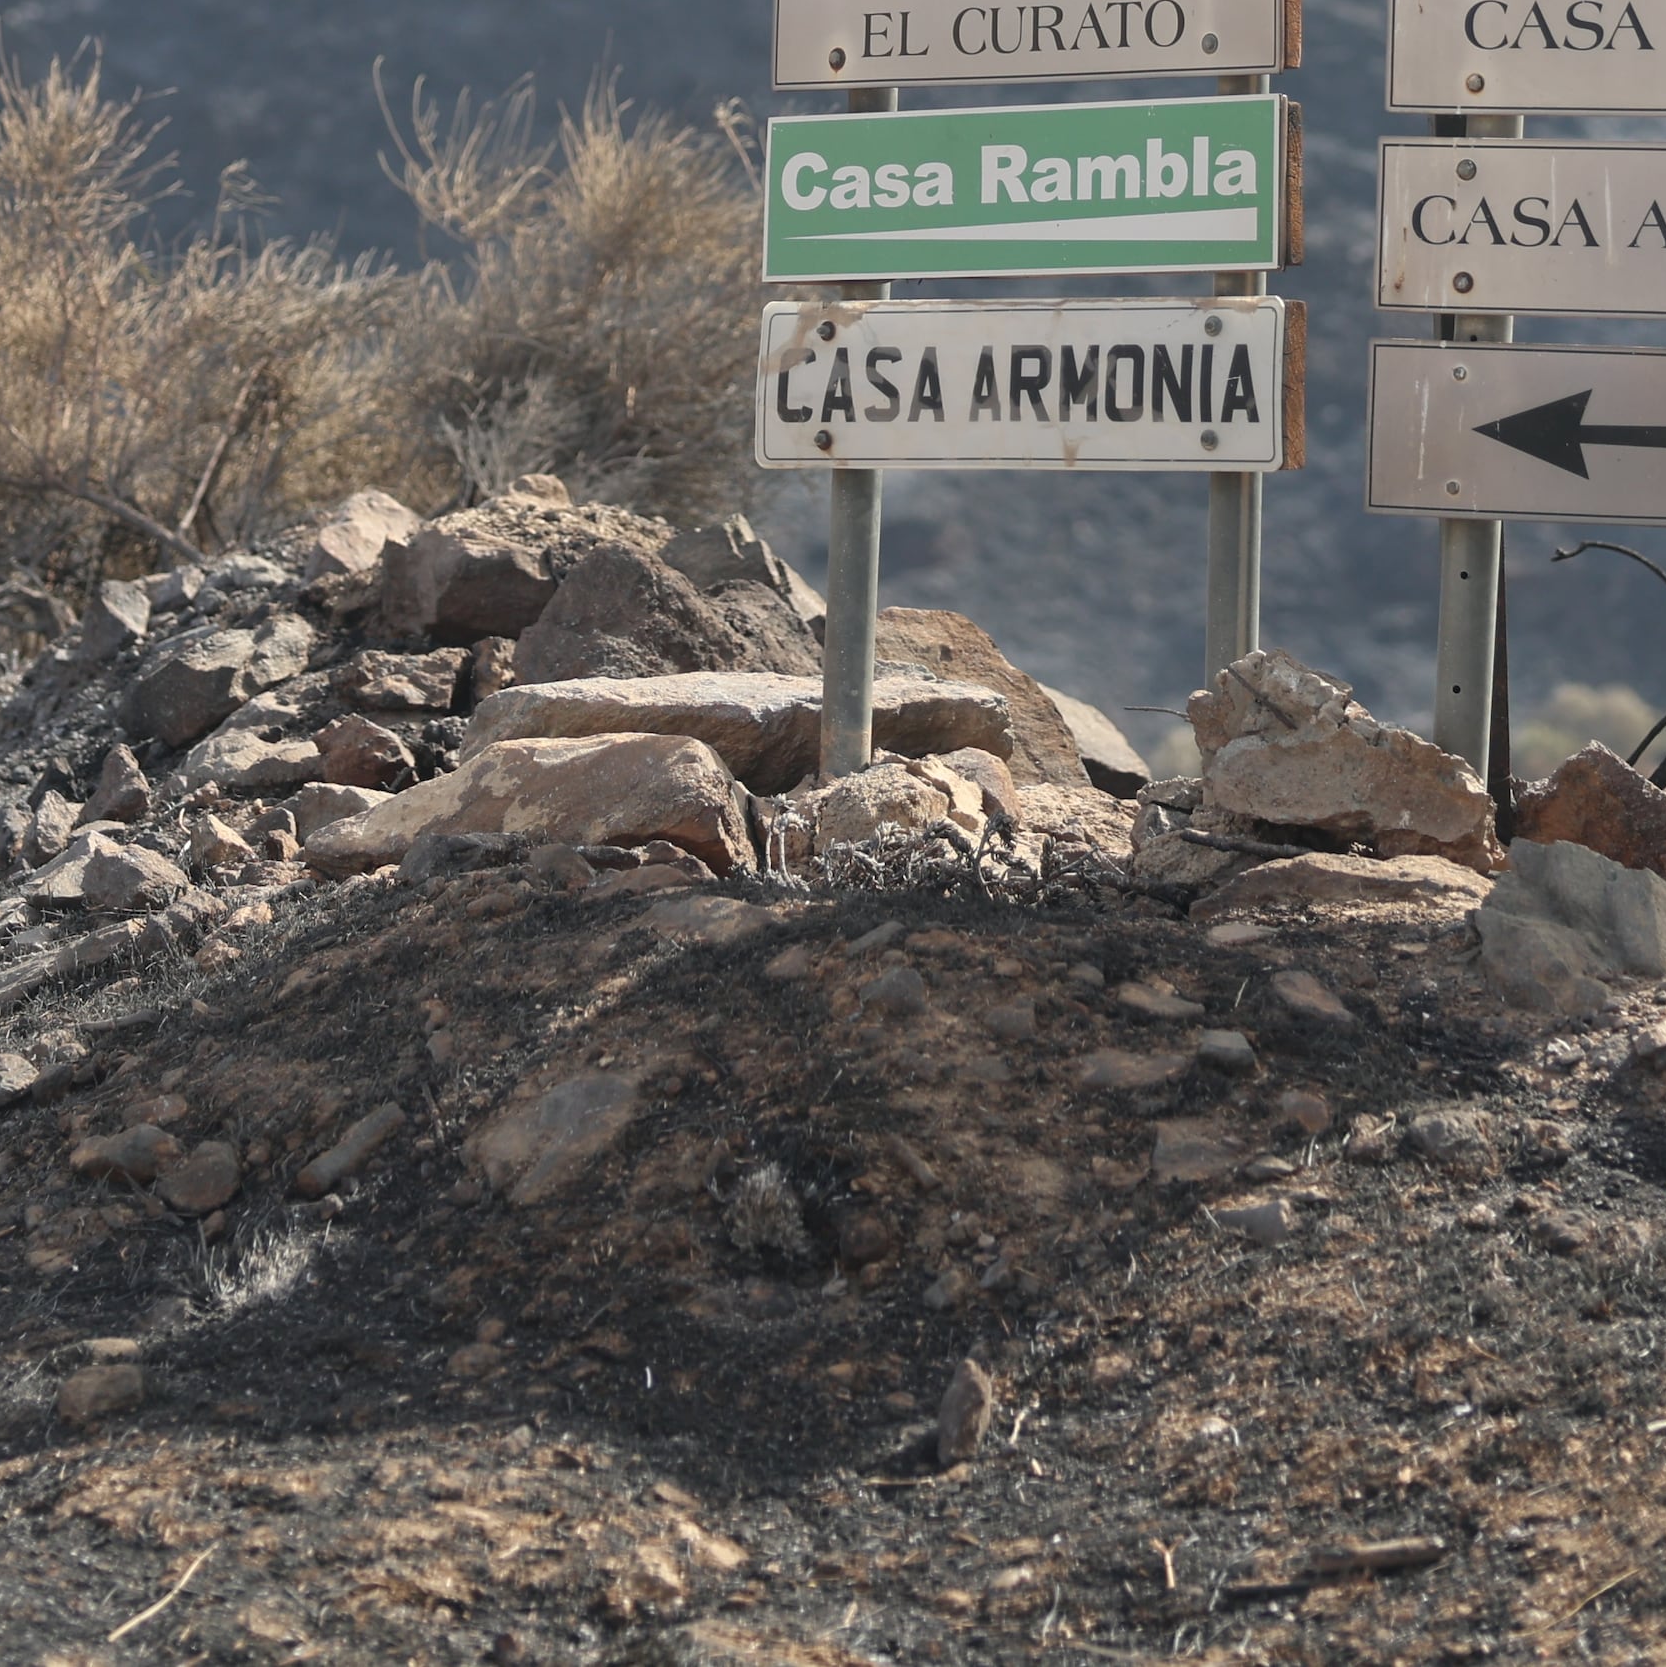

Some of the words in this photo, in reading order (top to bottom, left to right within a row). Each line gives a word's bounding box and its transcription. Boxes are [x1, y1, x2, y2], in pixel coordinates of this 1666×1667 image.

[861, 11, 930, 59] EL
[1464, 0, 1652, 52] CASA
[780, 151, 955, 211] Casa
[980, 136, 1258, 205] Rambla
[1411, 194, 1604, 249] CASA
[776, 345, 946, 423] CASA
